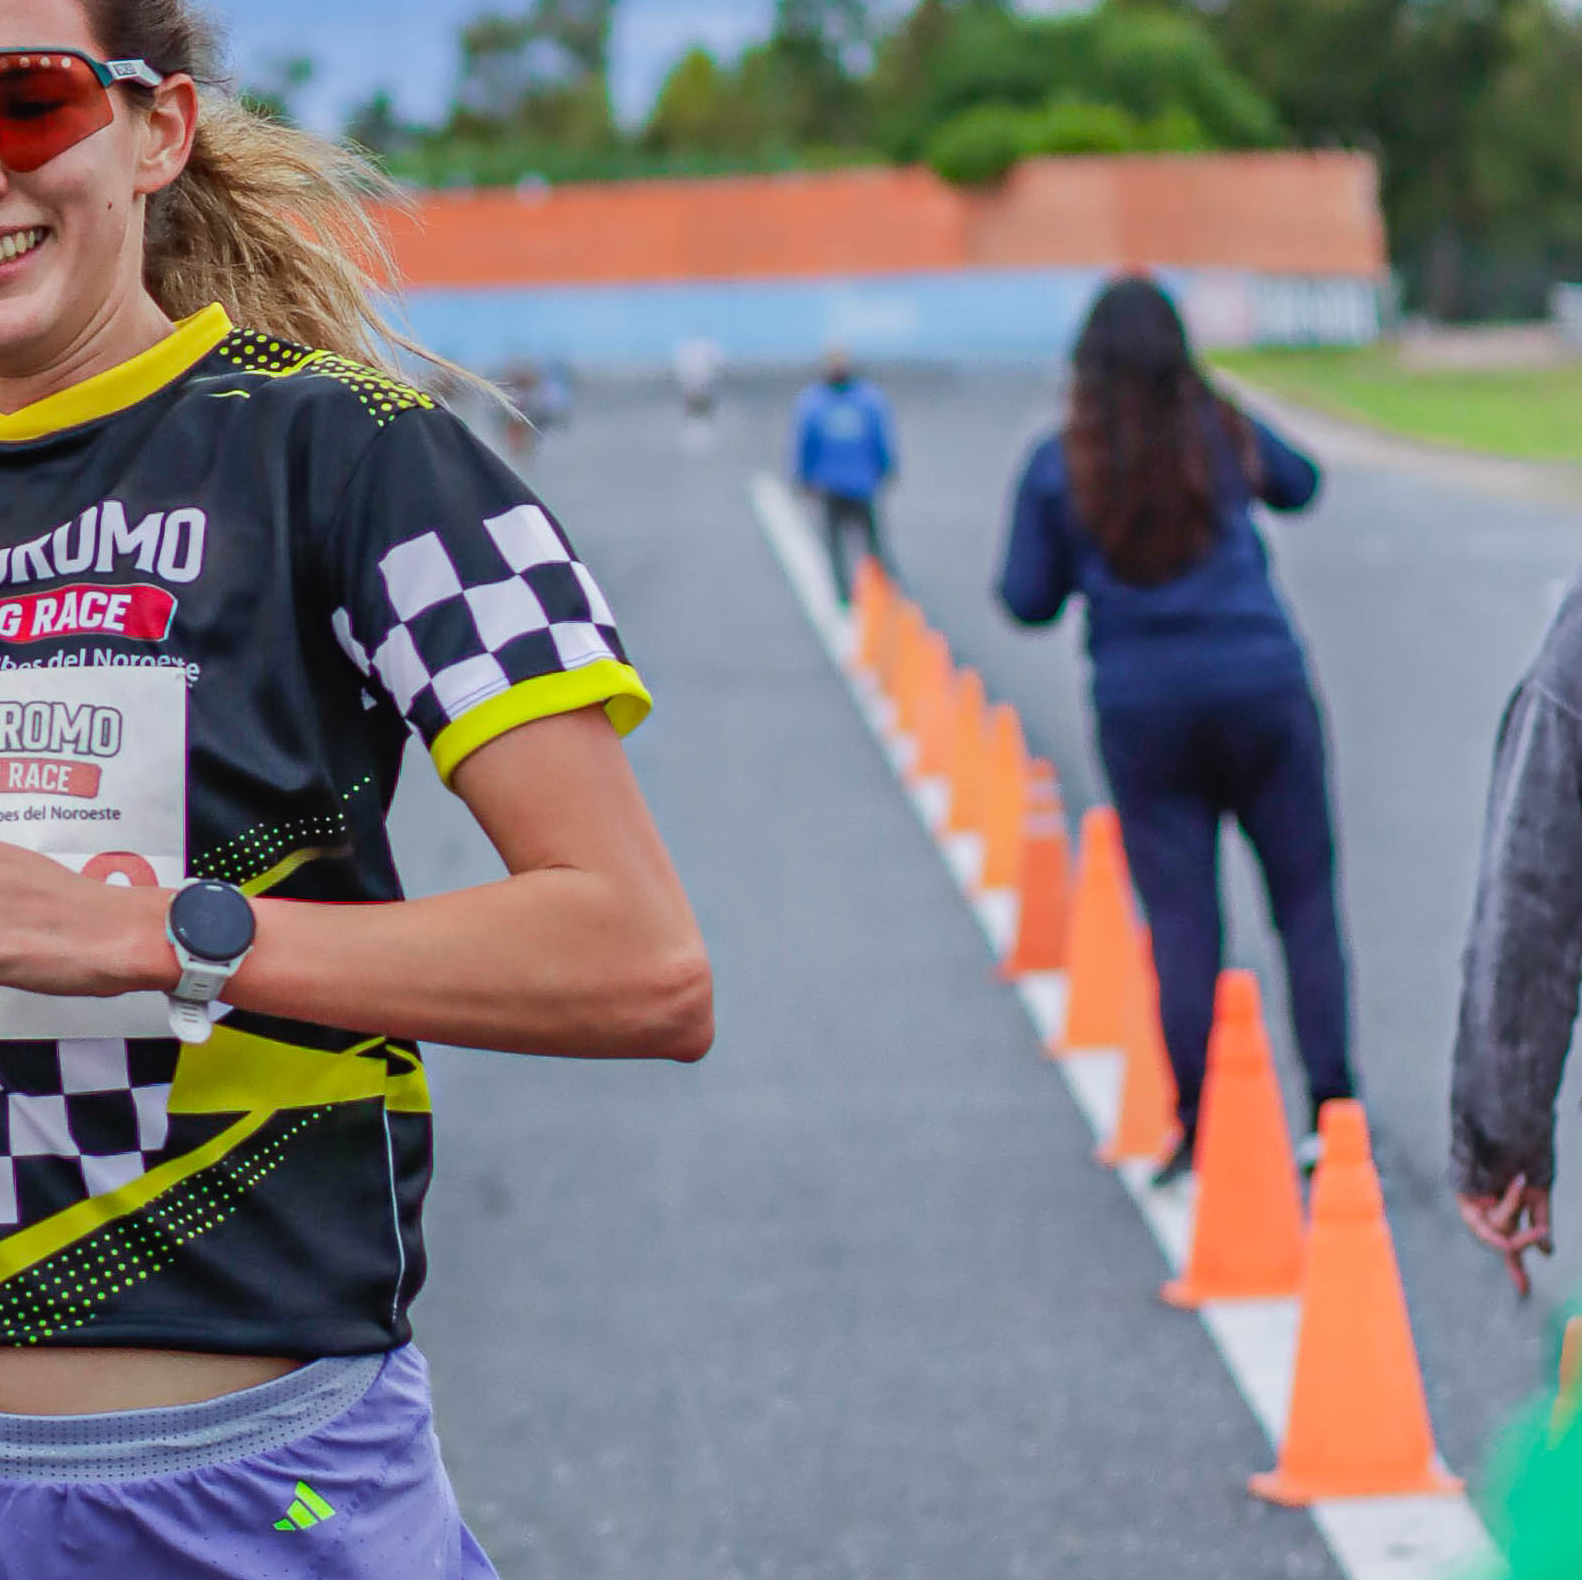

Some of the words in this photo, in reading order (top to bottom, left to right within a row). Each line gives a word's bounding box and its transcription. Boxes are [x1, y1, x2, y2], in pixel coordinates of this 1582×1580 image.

[30, 591, 132, 637] RACE
[48, 647, 87, 669] del
[8, 762, 73, 792] RACE
[23, 805, 47, 821] del
[50, 805, 122, 821] Noroeste
